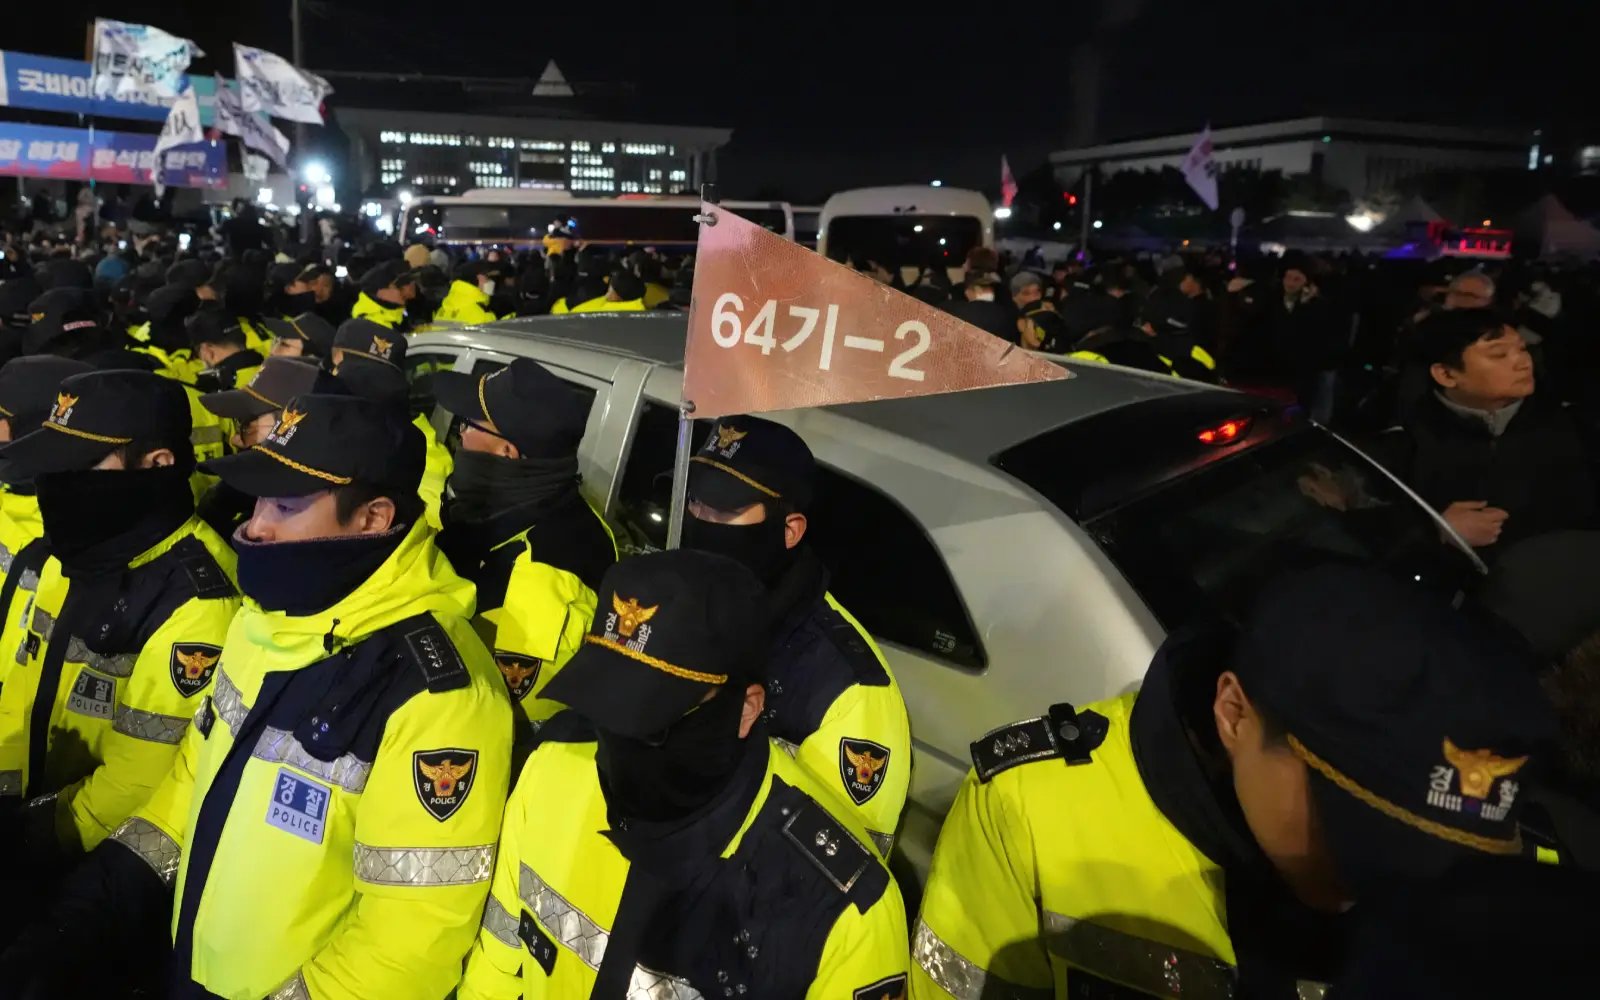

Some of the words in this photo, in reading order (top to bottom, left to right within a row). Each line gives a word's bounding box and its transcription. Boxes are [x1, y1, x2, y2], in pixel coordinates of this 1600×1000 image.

[711, 292, 931, 382] 64기-2
[71, 696, 108, 714] POLICE
[851, 781, 872, 792] POLICE
[430, 797, 457, 805] POLICE
[272, 807, 319, 836] POLICE
